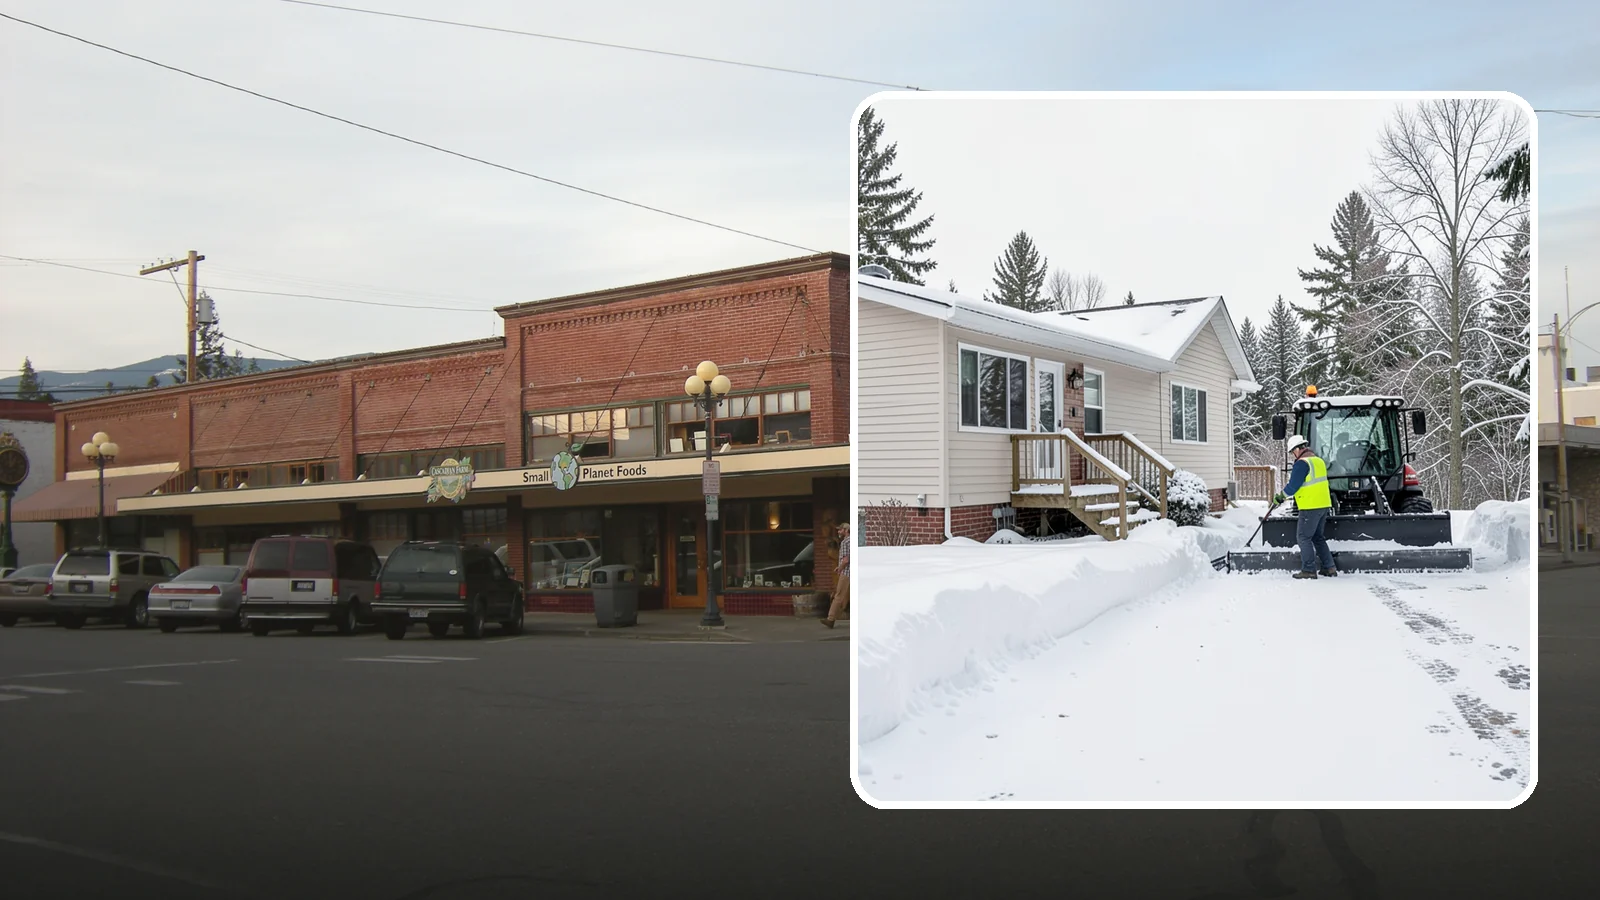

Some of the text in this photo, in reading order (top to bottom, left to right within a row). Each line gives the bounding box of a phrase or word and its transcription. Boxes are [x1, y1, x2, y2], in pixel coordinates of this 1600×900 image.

[523, 464, 647, 483] Small Planet Foods
